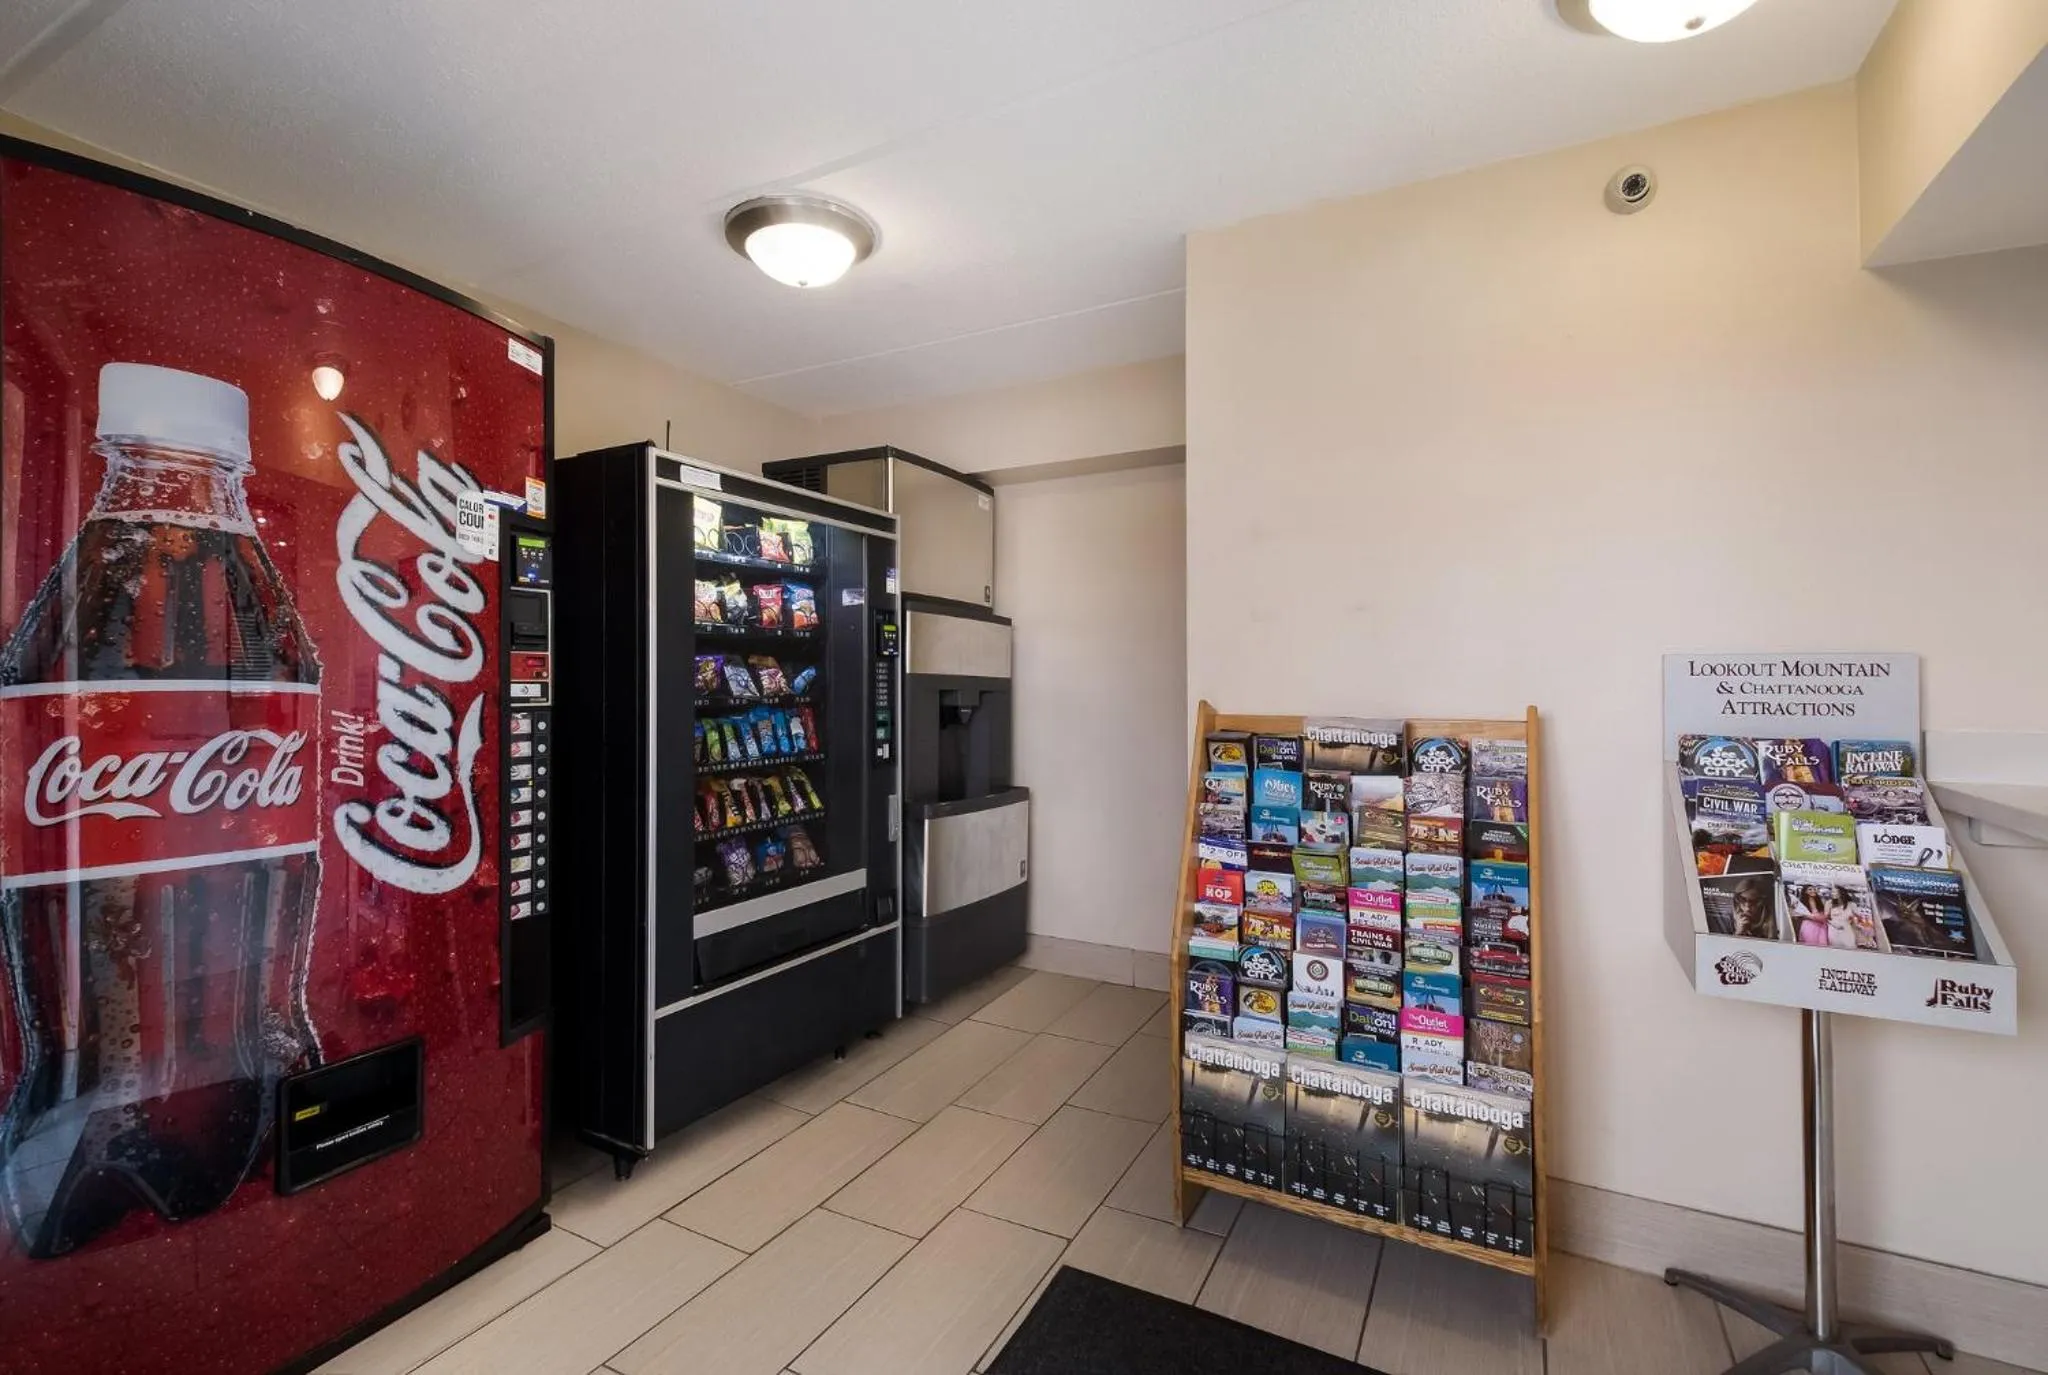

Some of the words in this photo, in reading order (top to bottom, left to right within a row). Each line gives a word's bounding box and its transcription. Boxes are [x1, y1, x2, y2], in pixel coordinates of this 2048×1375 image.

[334, 411, 486, 894] Coca-Cola
[1688, 660, 1777, 677] LOOKOUT
[1781, 660, 1891, 677] MOUNTAIN
[1716, 681, 1734, 695] &
[1740, 681, 1864, 696] CHATTANOOGA
[1721, 699, 1856, 717] ATTRACTIONS
[1307, 727, 1397, 748] Chattanooga
[331, 710, 366, 788] Drink!
[1763, 741, 1804, 759] RUBY
[1846, 750, 1904, 763] INCLINE
[1419, 756, 1456, 765] ROCK
[1700, 757, 1748, 768] ROCK
[1776, 754, 1820, 766] FALLS
[1846, 760, 1904, 773] RAILWAY
[1422, 764, 1453, 772] CITY
[1703, 767, 1744, 777] CITY
[24, 728, 308, 827] Coca-Cola
[1476, 785, 1512, 800] RUBY
[1487, 795, 1522, 808] FALLS
[1703, 797, 1732, 810] CIVIL
[1734, 801, 1758, 814] WAR
[1873, 833, 1915, 845] LODGE
[1366, 892, 1393, 905] Outlet
[1351, 929, 1385, 941] TRAINS
[1351, 937, 1373, 947] CIVIL
[1373, 940, 1393, 950] WAR
[1244, 960, 1279, 974] ROCK
[1247, 970, 1275, 981] CITY
[1820, 966, 1876, 985] INCLINE
[1190, 980, 1219, 995] RUBY
[1818, 980, 1878, 997] RAILWAY
[1940, 979, 1994, 998] Ruby
[1940, 993, 1992, 1012] Falls
[1418, 1015, 1448, 1029] Outlet
[1189, 1042, 1280, 1080] Chattanooga
[1291, 1064, 1393, 1106] Chattanooga
[1410, 1089, 1524, 1131] Chattanooga
